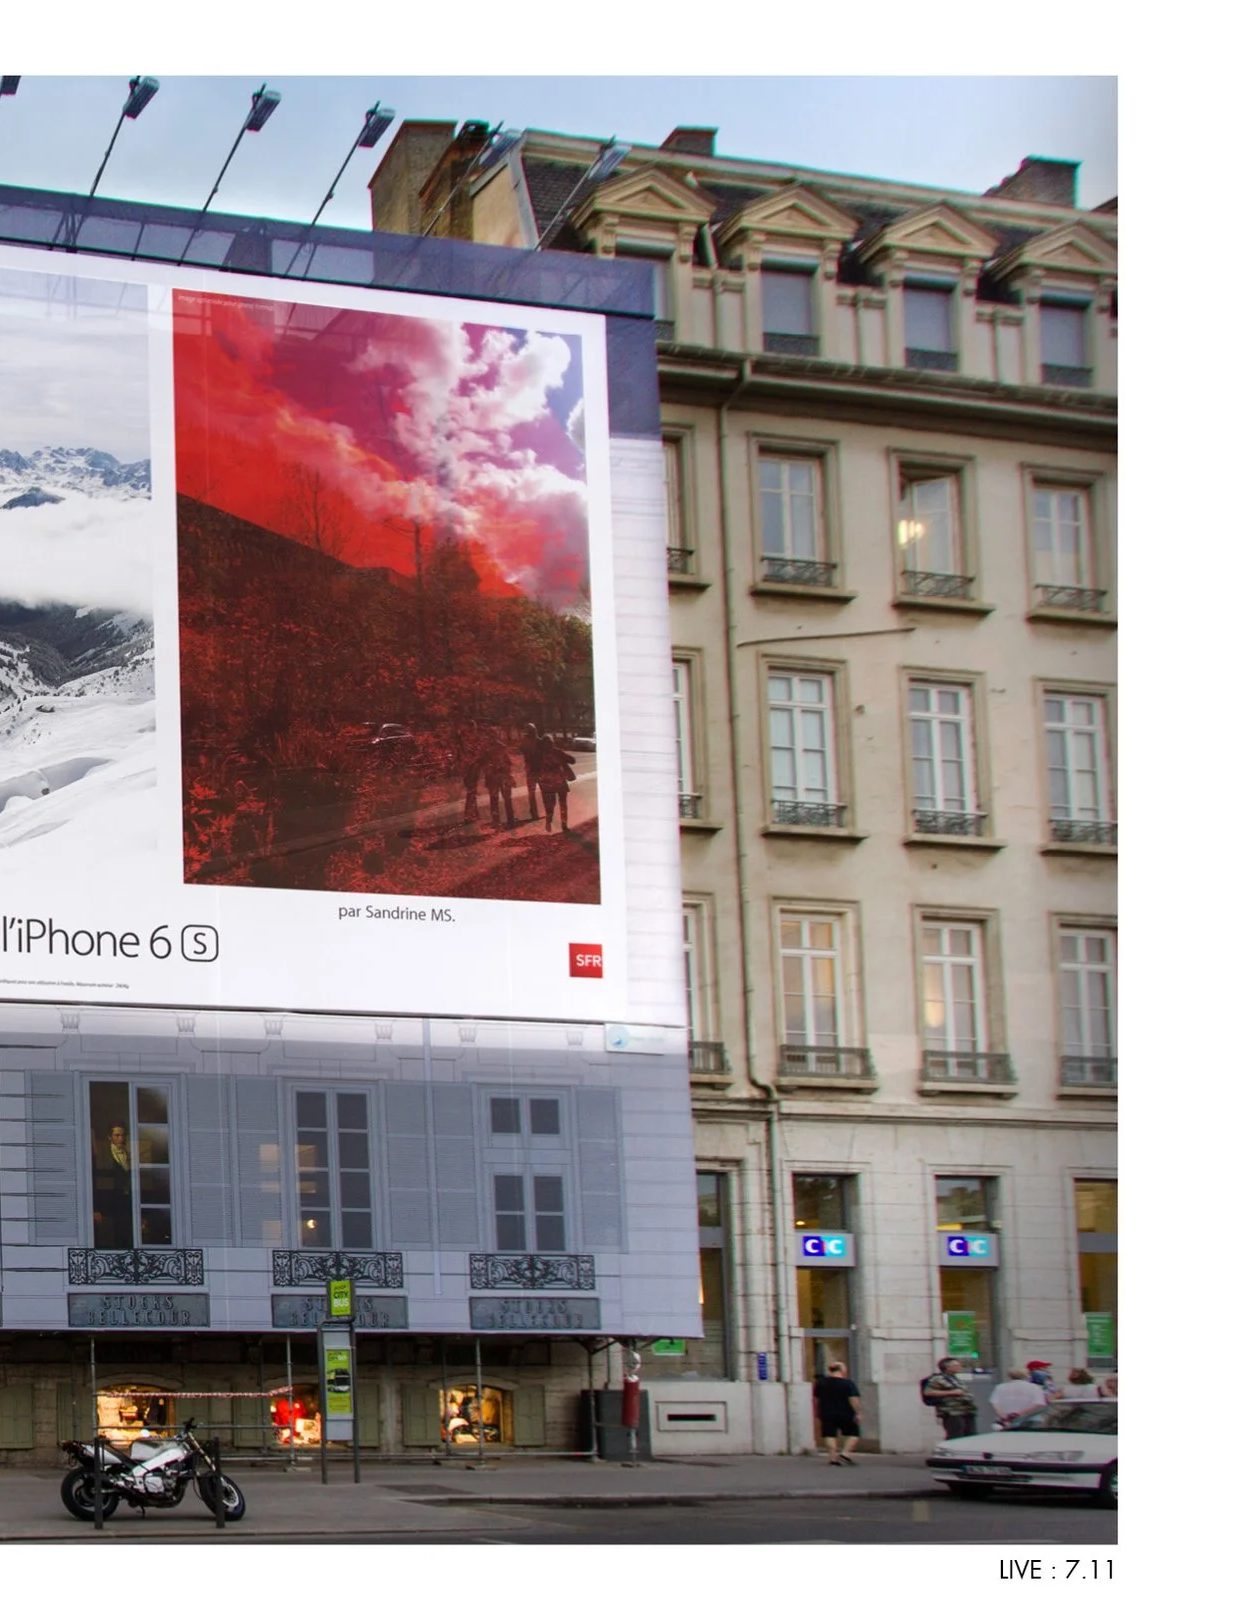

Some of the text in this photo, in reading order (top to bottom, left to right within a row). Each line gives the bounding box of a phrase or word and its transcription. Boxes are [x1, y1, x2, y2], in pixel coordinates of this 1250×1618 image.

[338, 905, 456, 922] par Sandrine MS.
[149, 924, 172, 960] 6
[575, 953, 601, 968] SFR
[804, 1238, 843, 1255] CIC
[949, 1238, 988, 1255] CIC
[102, 1295, 175, 1310] STOCKS
[333, 1291, 349, 1300] CITY
[333, 1298, 350, 1308] BUS
[87, 1310, 192, 1327] BELLECOUR
